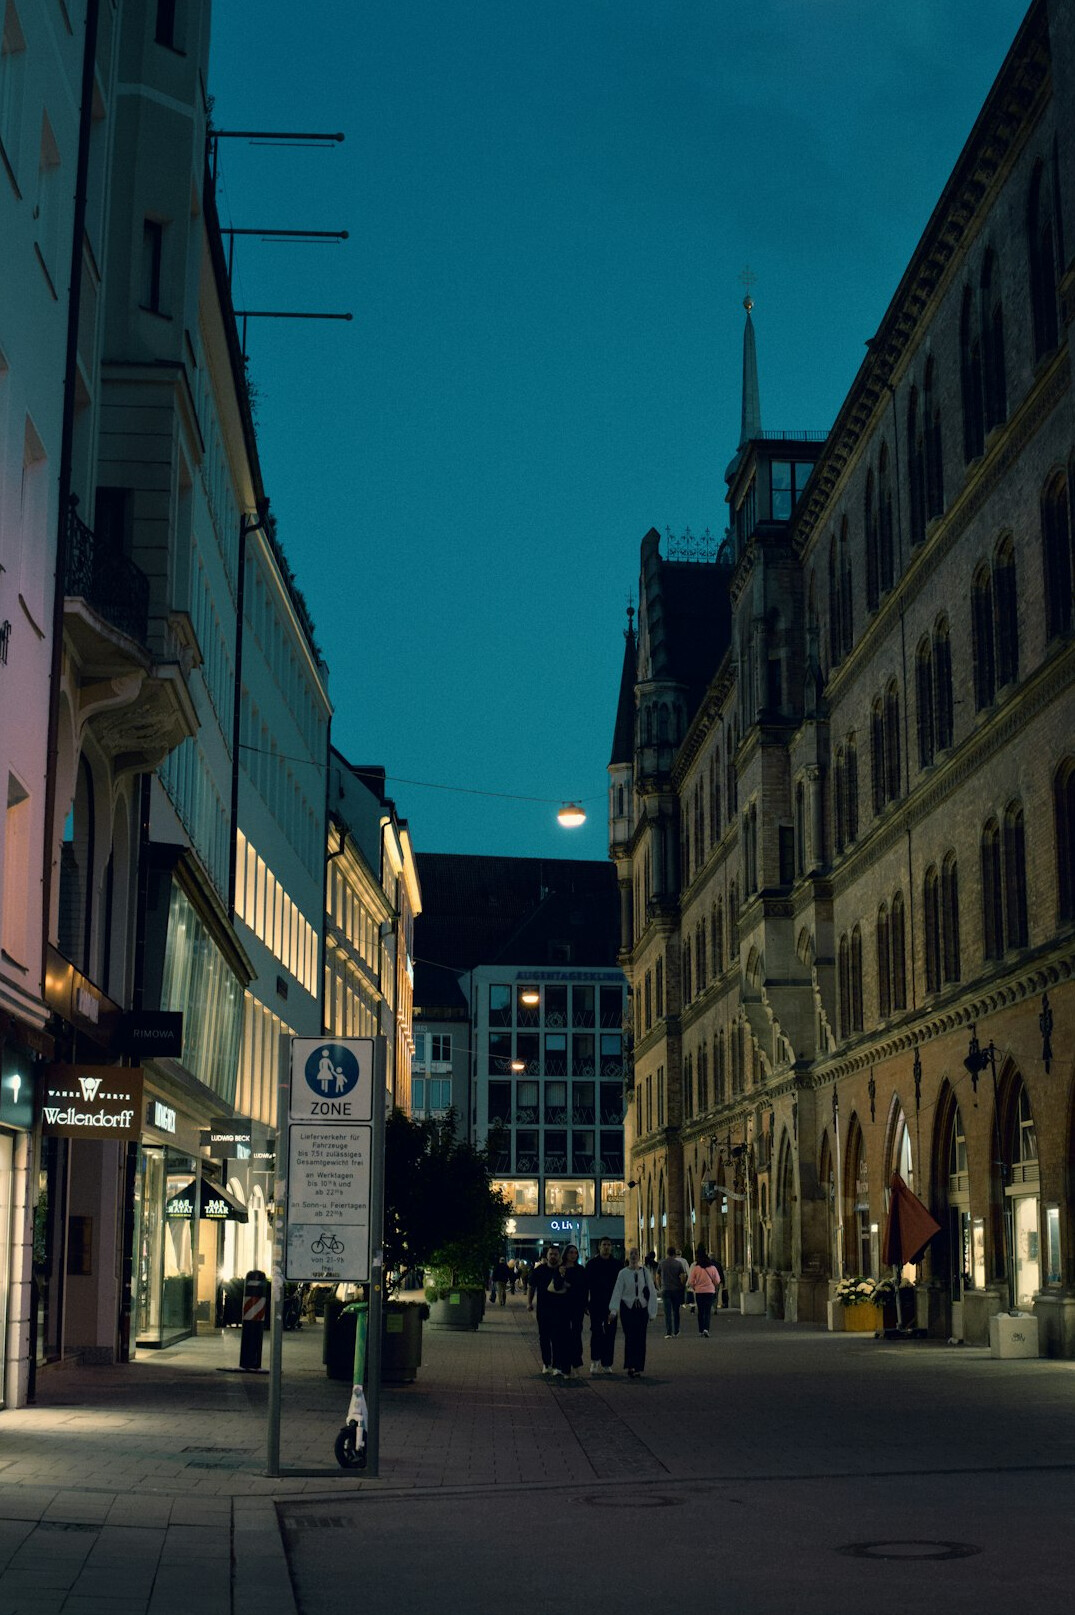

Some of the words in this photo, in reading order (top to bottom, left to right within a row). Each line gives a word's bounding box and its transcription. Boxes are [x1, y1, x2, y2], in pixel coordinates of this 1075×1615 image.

[133, 1029, 175, 1039] RIMOWA
[310, 1102, 352, 1116] ZONE
[43, 1107, 134, 1128] Wellendorff
[211, 1134, 234, 1142] LUDWIG
[235, 1134, 251, 1142] BECK
[312, 1142, 348, 1150] Fahrzeuge
[317, 1171, 354, 1180] Werktagen
[208, 1199, 225, 1208] BAR
[330, 1201, 367, 1211] Feiertagen
[204, 1205, 229, 1214] TATAR
